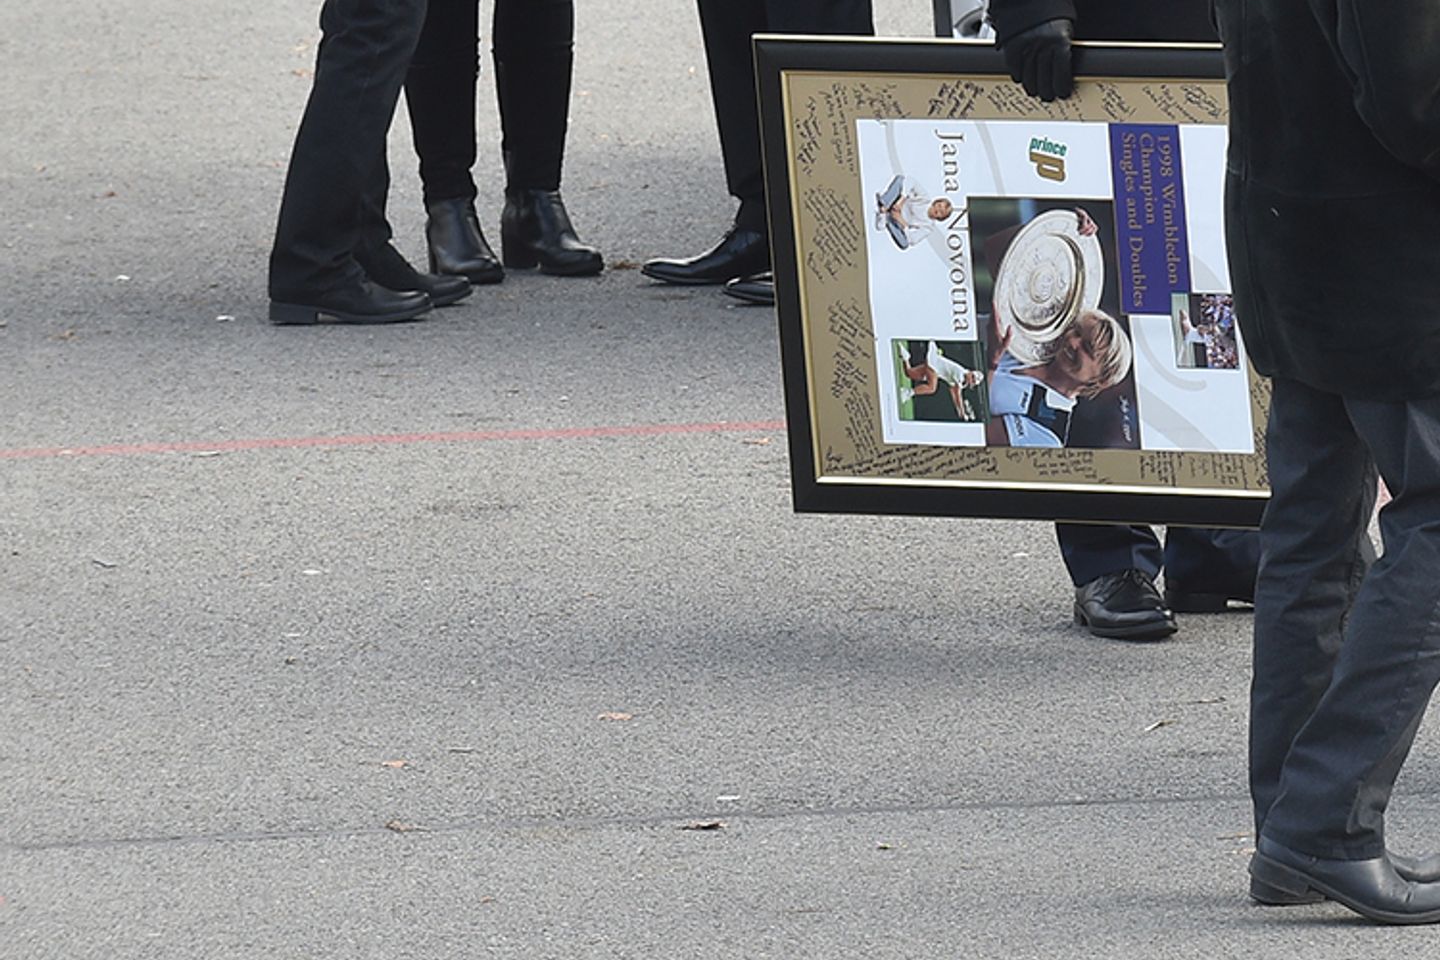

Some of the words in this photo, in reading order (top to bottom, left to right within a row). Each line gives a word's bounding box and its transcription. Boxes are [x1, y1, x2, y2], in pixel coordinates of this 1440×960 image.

[935, 129, 965, 192] Jana
[1030, 137, 1067, 156] prince
[1119, 133, 1138, 192] Singles
[1157, 135, 1174, 177] 1998
[1138, 133, 1157, 224] Champion
[1126, 198, 1143, 229] and
[1160, 182, 1181, 284] Wimbledon
[946, 206, 969, 332] Novotna
[1129, 236, 1147, 307] Doubles
